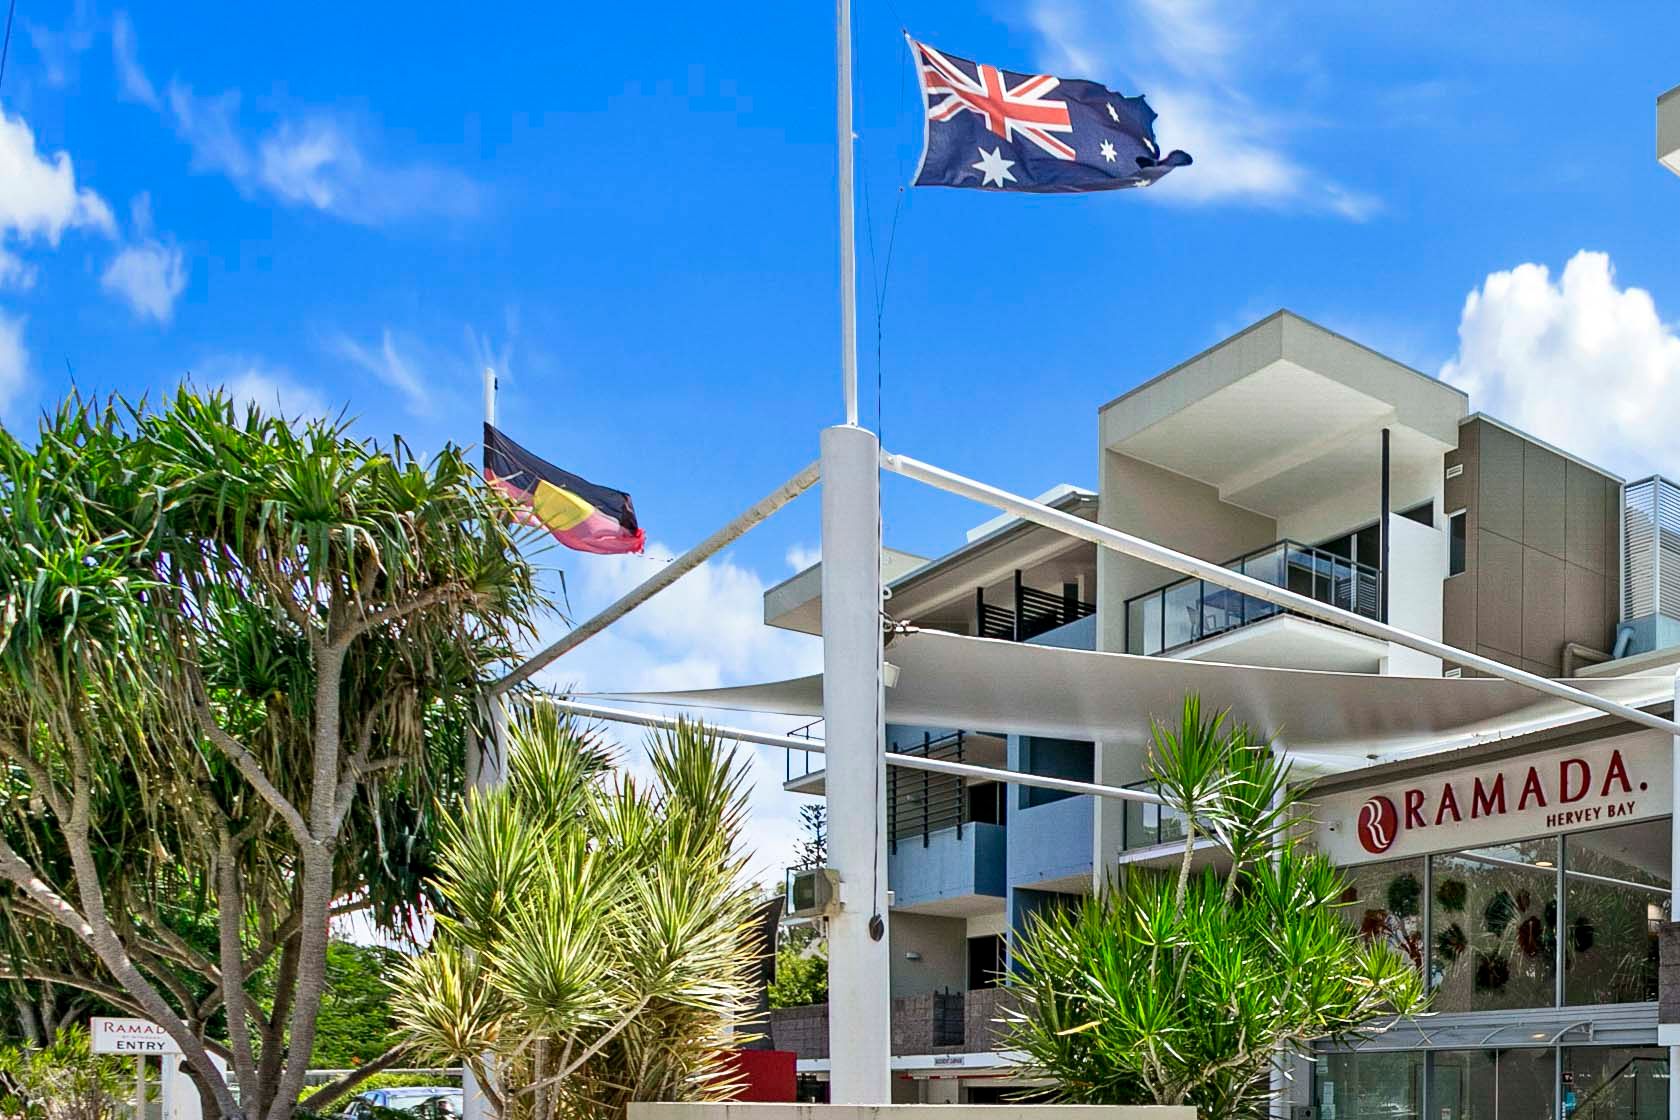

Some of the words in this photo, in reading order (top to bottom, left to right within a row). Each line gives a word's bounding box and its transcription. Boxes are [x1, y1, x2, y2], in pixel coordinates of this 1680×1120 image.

[1546, 807, 1602, 829] HERVEY
[1607, 801, 1637, 819] BAY
[104, 1021, 167, 1034] RAMAD
[116, 1040, 166, 1051] ENTRY
